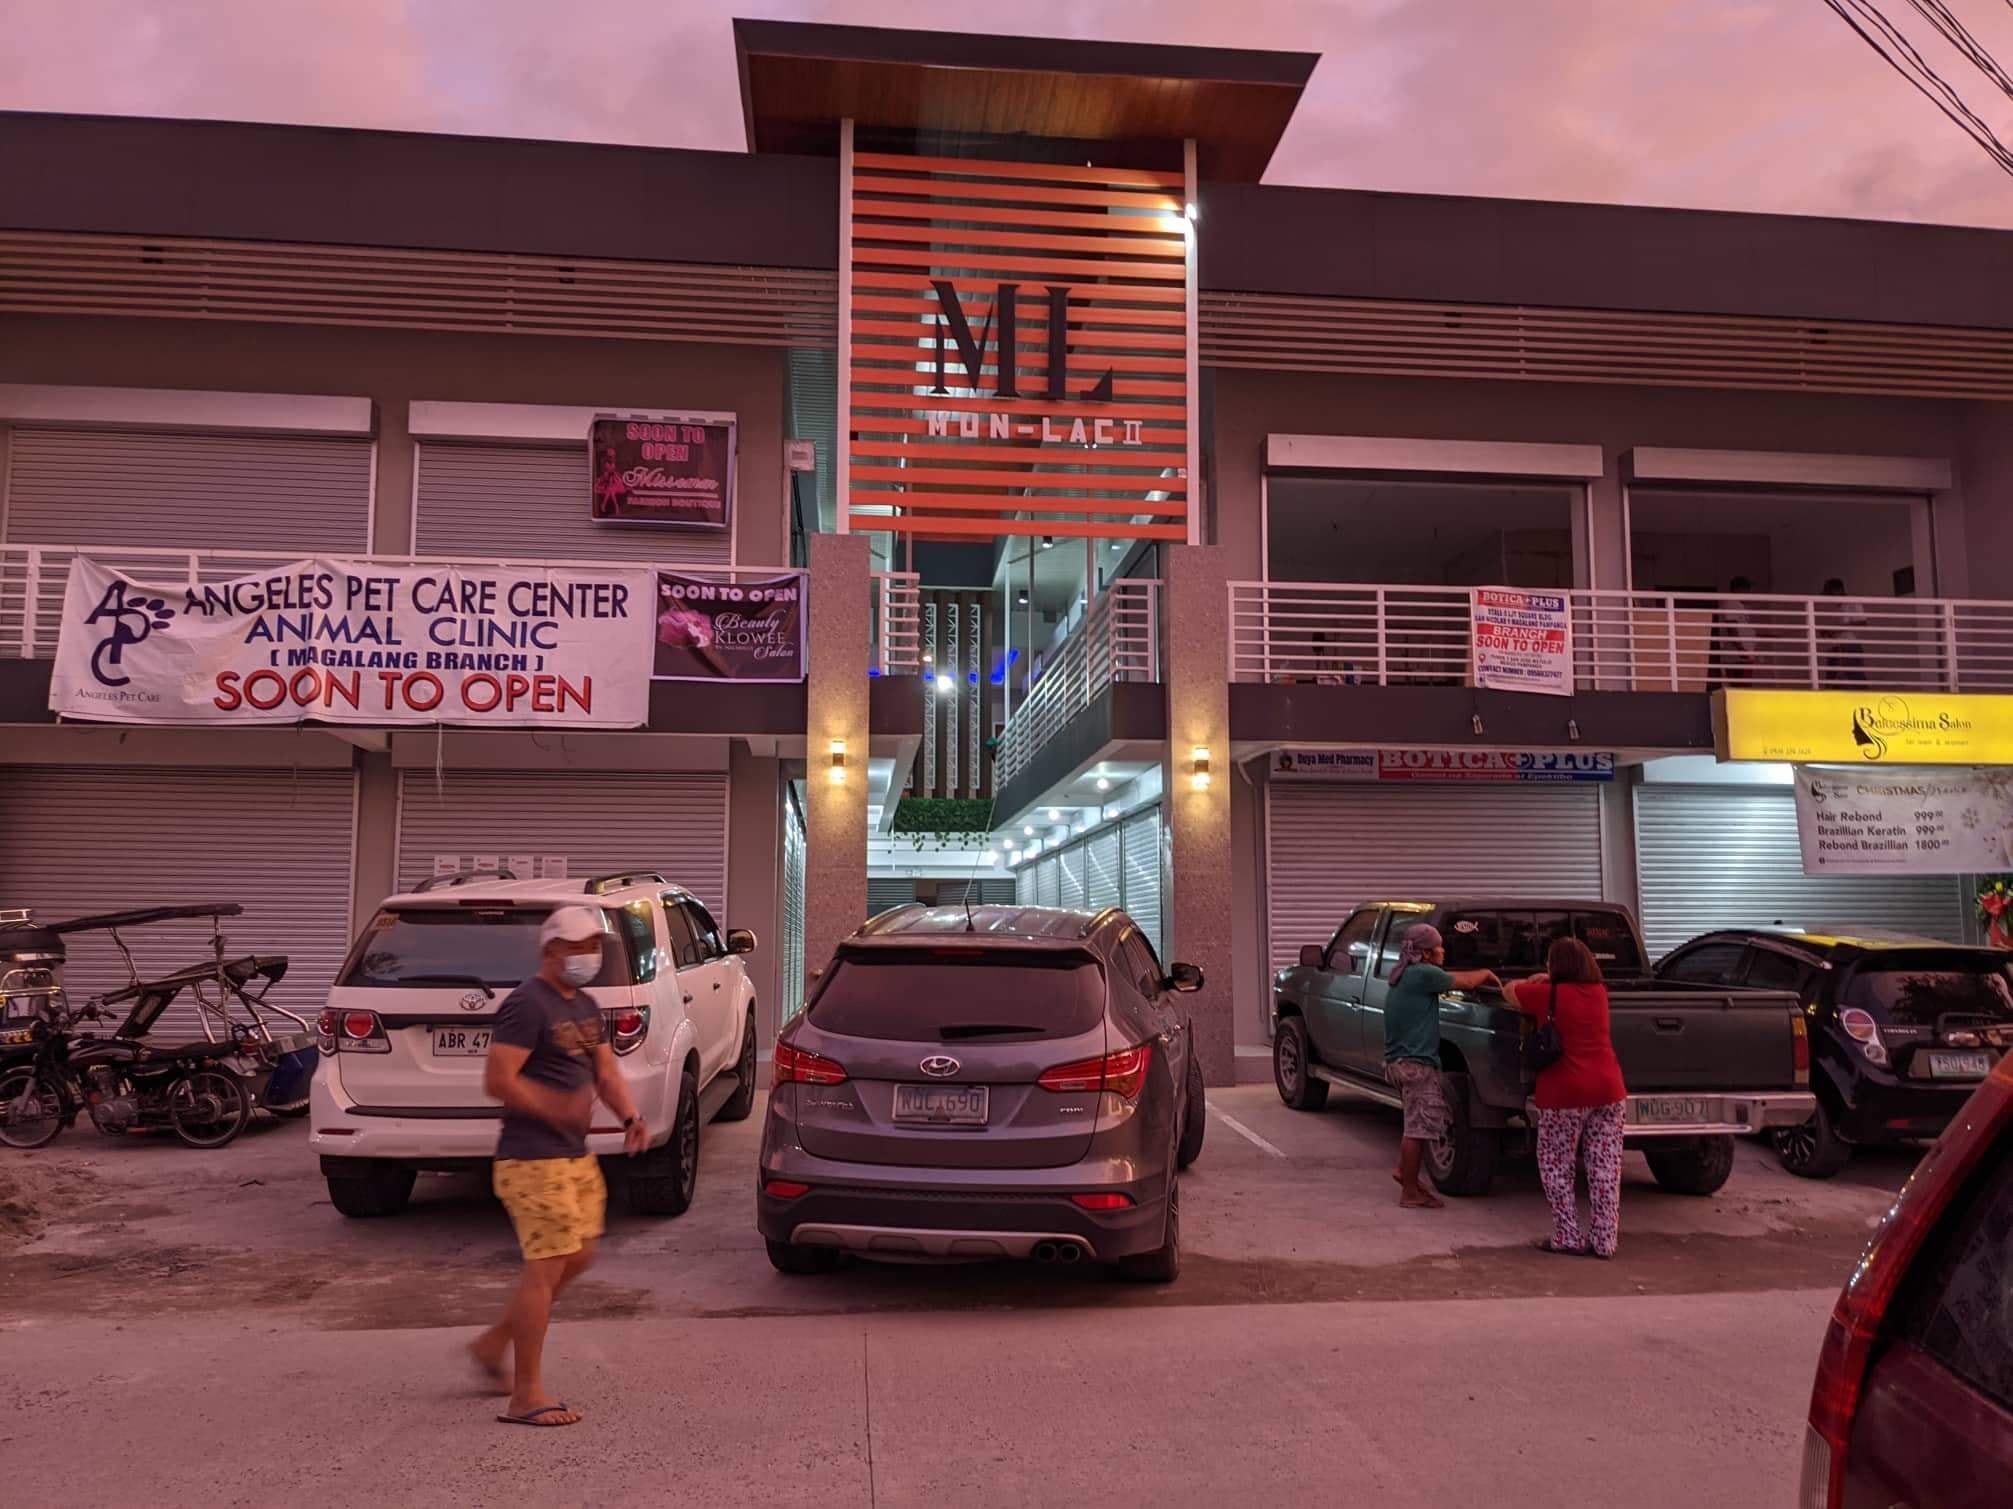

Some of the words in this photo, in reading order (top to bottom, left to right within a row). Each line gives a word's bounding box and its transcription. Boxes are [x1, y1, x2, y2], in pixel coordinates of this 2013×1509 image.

[930, 280, 1113, 401] ML
[626, 423, 677, 442] SOON
[681, 426, 705, 444] TO
[641, 442, 689, 462] OPEN
[184, 573, 333, 617] ANGELES
[347, 576, 401, 612] PET
[412, 577, 497, 614] CARE
[508, 582, 628, 618] CENTER
[661, 583, 716, 600] SOON
[719, 587, 744, 601] TO
[749, 587, 797, 602] OPEN
[1483, 591, 1522, 605] BOTICA
[1532, 596, 1559, 609] PLUS
[244, 612, 402, 646] ANIMAL
[429, 617, 560, 650] CLINIC
[715, 631, 786, 645] KLOWEE
[1493, 626, 1548, 641] BRANCH
[1476, 635, 1509, 650] SOON
[1513, 639, 1528, 652] TO
[1532, 641, 1564, 654] OPEN
[213, 667, 361, 712] SOON
[379, 671, 444, 712] TO
[461, 672, 592, 715] OPEN
[1939, 712, 1971, 730] Salon
[1336, 753, 1374, 767] Pharmacy
[1383, 750, 1506, 769] BOTICA
[1532, 752, 1613, 770] PLUS
[1816, 811, 1835, 822] Hair
[1841, 811, 1882, 822] Rebond
[1818, 825, 1863, 836] Brazillian
[1867, 825, 1906, 836] Keratin
[1819, 839, 1858, 850] Rebond
[1861, 839, 1908, 850] Brazillian
[1915, 839, 1941, 850] 1800
[438, 1032, 465, 1049] ABR
[472, 1032, 494, 1049] 47
[946, 1093, 980, 1112] 690
